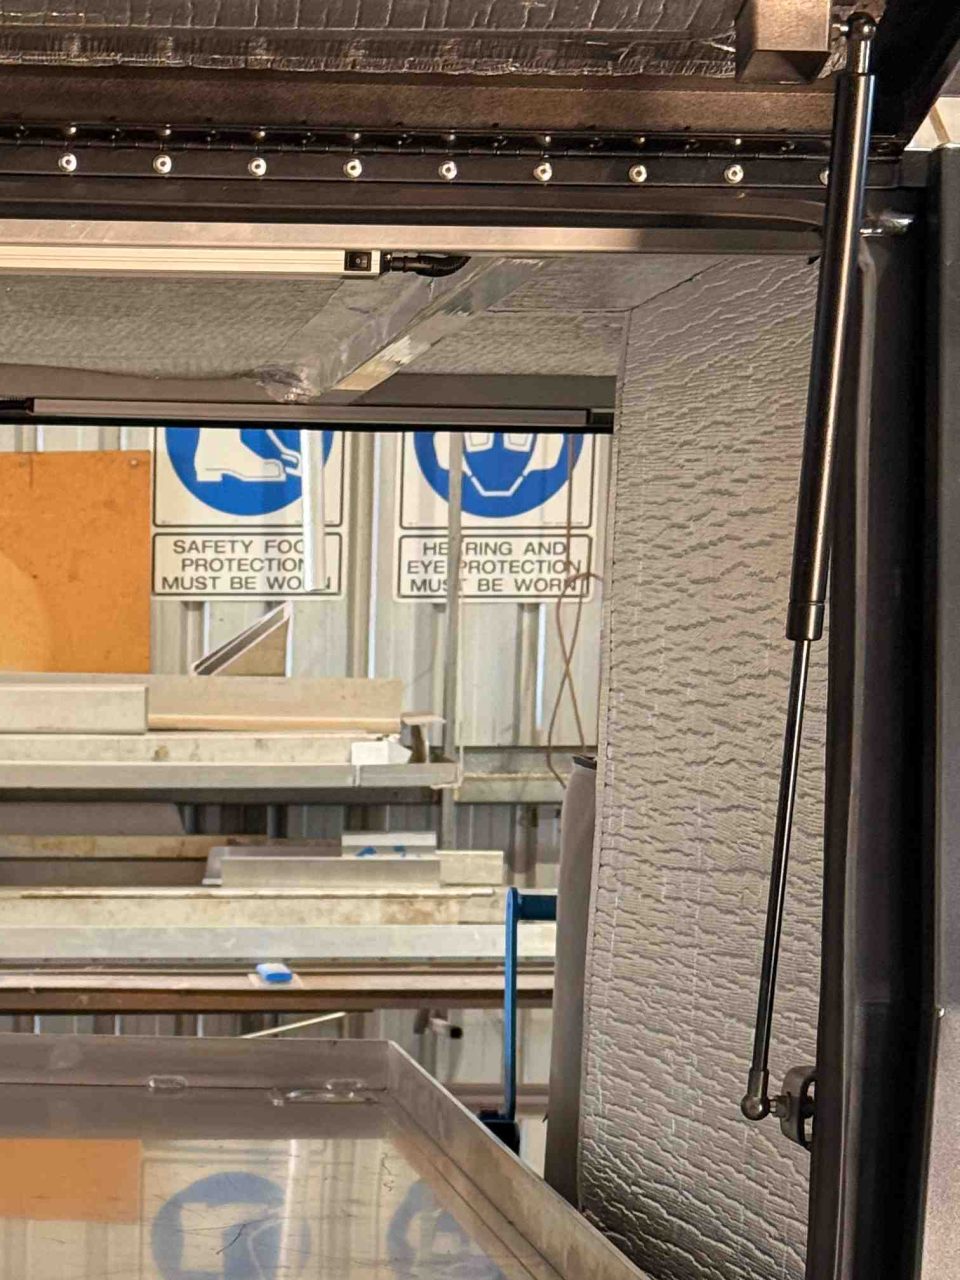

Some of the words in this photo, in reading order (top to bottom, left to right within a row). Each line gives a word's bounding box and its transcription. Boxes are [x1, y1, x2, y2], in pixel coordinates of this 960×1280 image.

[173, 539, 253, 554] SAFETY
[265, 539, 305, 554] FOO
[423, 541, 513, 556] HERING
[524, 542, 566, 556] AND
[407, 560, 444, 575] EYE
[162, 576, 220, 590] MUST
[230, 577, 257, 590] BE
[267, 576, 331, 591] WO
[478, 578, 503, 592] BE
